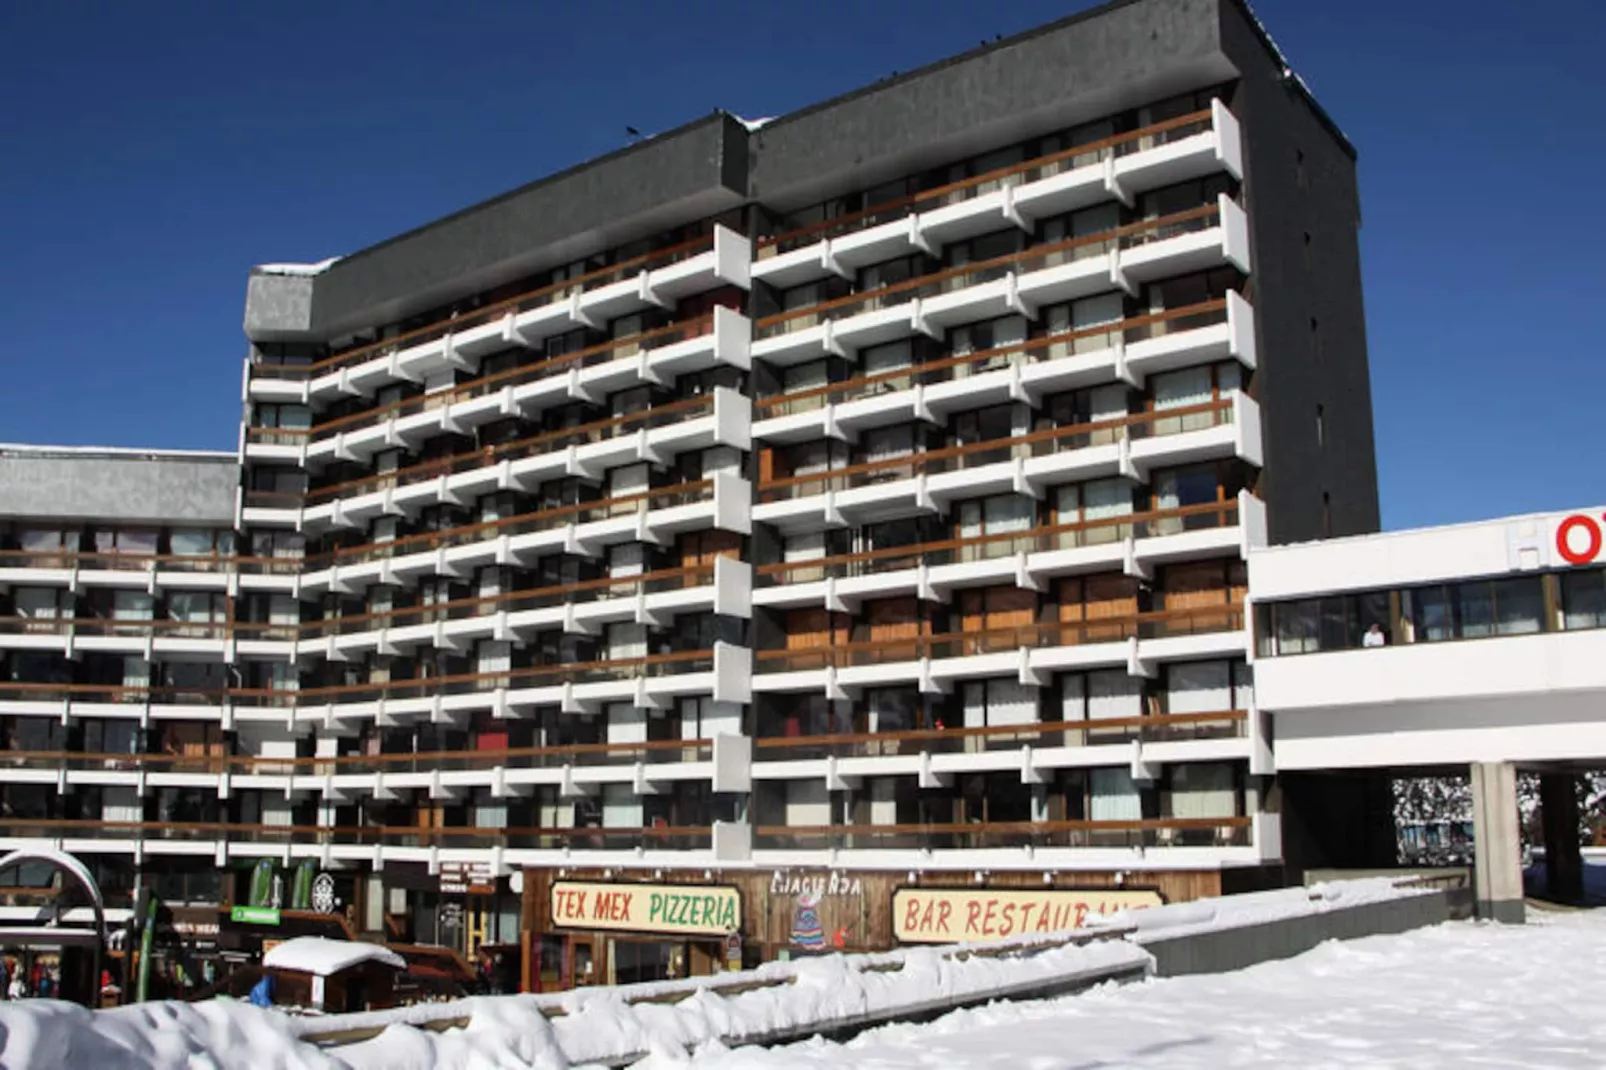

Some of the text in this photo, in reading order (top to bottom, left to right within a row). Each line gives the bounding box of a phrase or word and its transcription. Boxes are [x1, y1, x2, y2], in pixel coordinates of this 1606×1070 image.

[555, 890, 736, 926] TEX MEX PIZZERIA
[904, 898, 1149, 936] BAR RESTAUR
